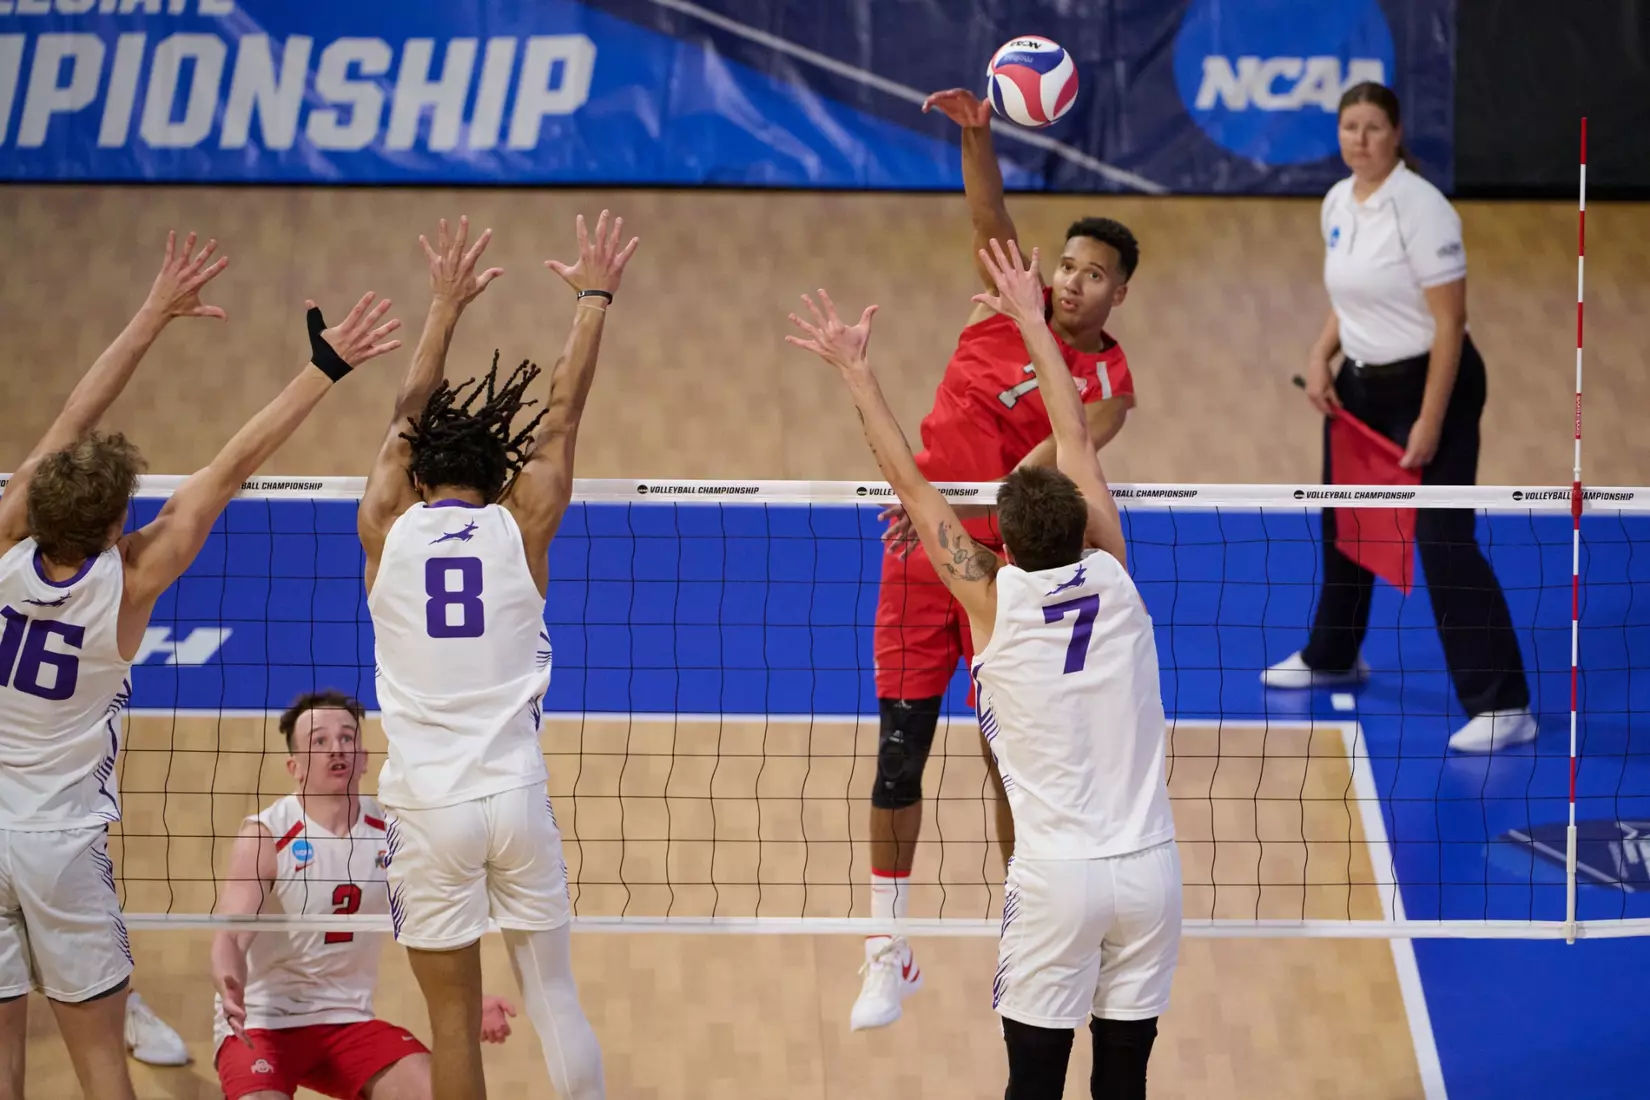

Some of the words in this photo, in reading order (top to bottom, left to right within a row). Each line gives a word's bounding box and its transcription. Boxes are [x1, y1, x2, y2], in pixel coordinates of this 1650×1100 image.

[0, 32, 597, 151] PIONSHIP
[261, 482, 323, 490] CHAMPIONSHIP
[650, 486, 696, 494] VOLLEYBALL
[698, 486, 759, 494] CHAMPIONSHIP
[938, 488, 979, 496] PIONSHIP
[1136, 490, 1198, 498] CHAMPIONSHIP
[1306, 491, 1352, 499] VOLLEYBALL
[1354, 491, 1416, 499] CHAMPIONSHIP
[1525, 492, 1571, 500] VOLLEYBALL
[1581, 492, 1635, 501] AMPIONSHIP
[425, 556, 485, 638] 8
[1042, 593, 1100, 675] 7
[0, 605, 86, 700] 16
[324, 883, 362, 945] 2
